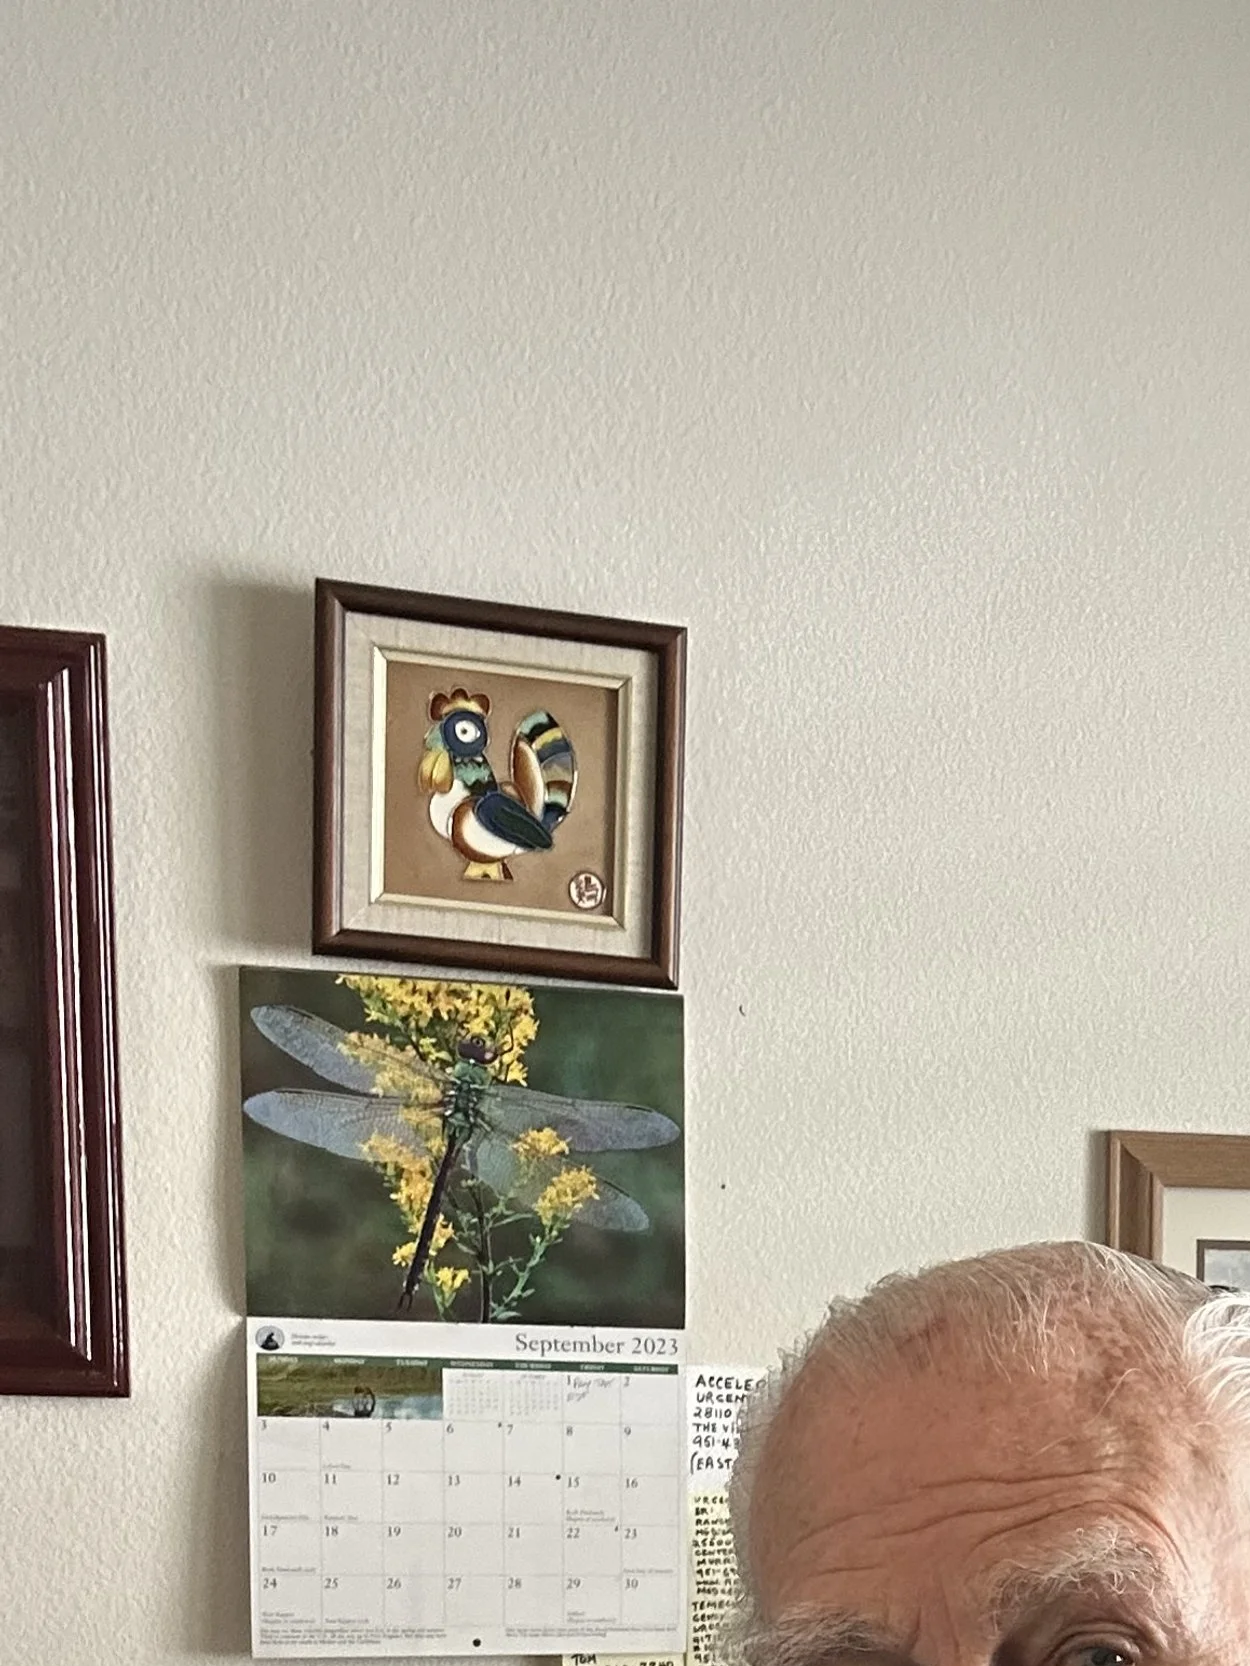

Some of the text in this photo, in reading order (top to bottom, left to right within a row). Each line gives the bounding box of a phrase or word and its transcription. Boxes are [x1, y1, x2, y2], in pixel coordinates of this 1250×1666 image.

[515, 1333, 679, 1358] September 2023
[623, 1375, 631, 1388] 2
[261, 1419, 632, 1436] 3 4 5 6 7 8 9
[262, 1472, 639, 1489] 10 11 12 13 14 15 16
[263, 1524, 638, 1540] 17 18 19 20 21 22 23
[263, 1577, 639, 1590] 24 25 26 27 28 29 30
